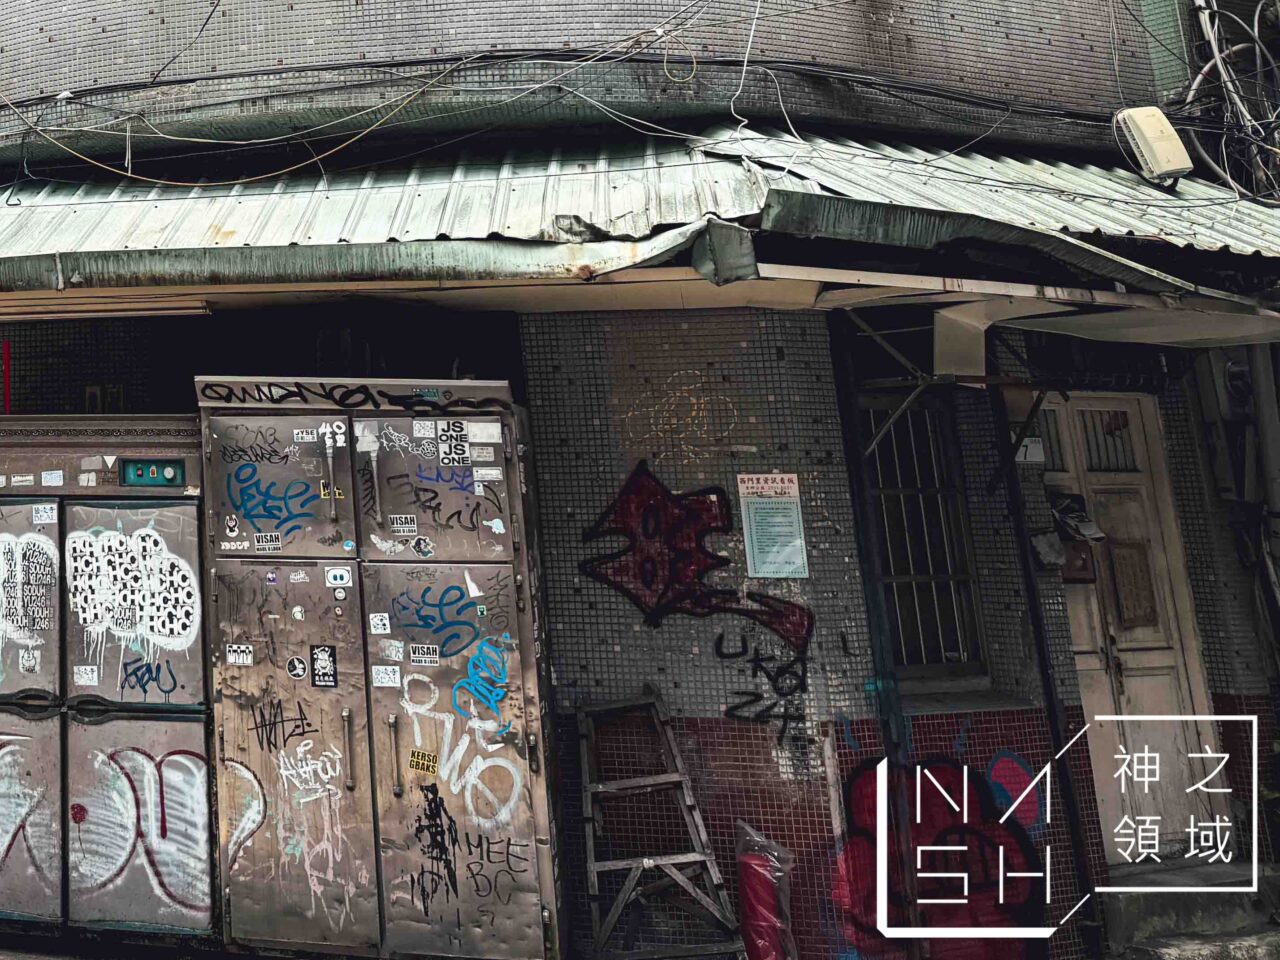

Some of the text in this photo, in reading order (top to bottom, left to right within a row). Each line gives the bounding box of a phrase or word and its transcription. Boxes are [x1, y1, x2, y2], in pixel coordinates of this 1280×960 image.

[441, 421, 464, 433] JS
[439, 434, 469, 442] ONE
[443, 443, 466, 456] JS
[440, 456, 471, 466] ONE
[389, 516, 416, 527] VISAH
[255, 534, 280, 544] VISAH
[411, 645, 438, 657] VISAH
[410, 750, 438, 765] KERSO
[408, 759, 437, 774] GBAKS
